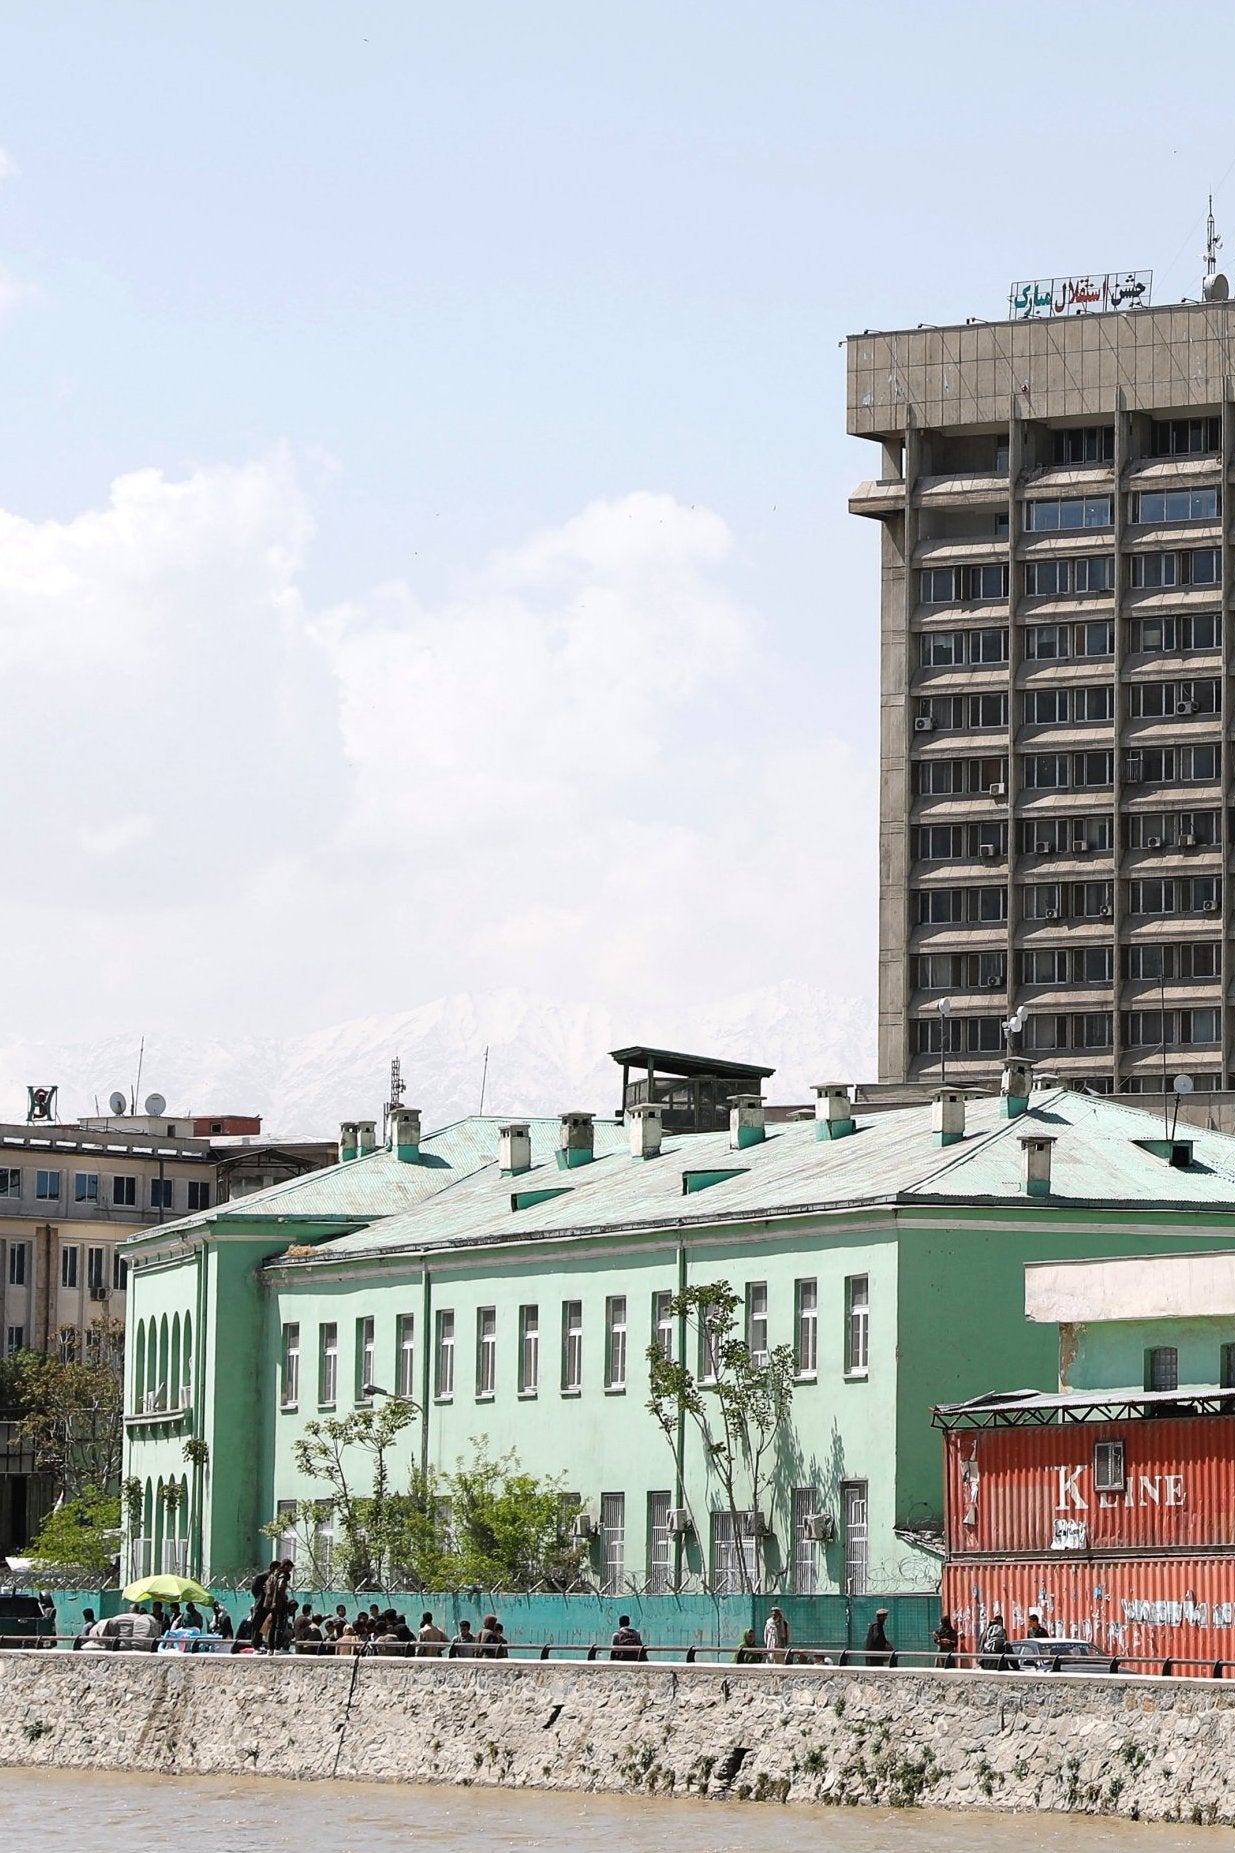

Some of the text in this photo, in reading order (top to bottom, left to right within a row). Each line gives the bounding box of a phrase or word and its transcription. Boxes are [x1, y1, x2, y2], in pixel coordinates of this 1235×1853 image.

[1014, 274, 1146, 316] جشن استقلال مبارک
